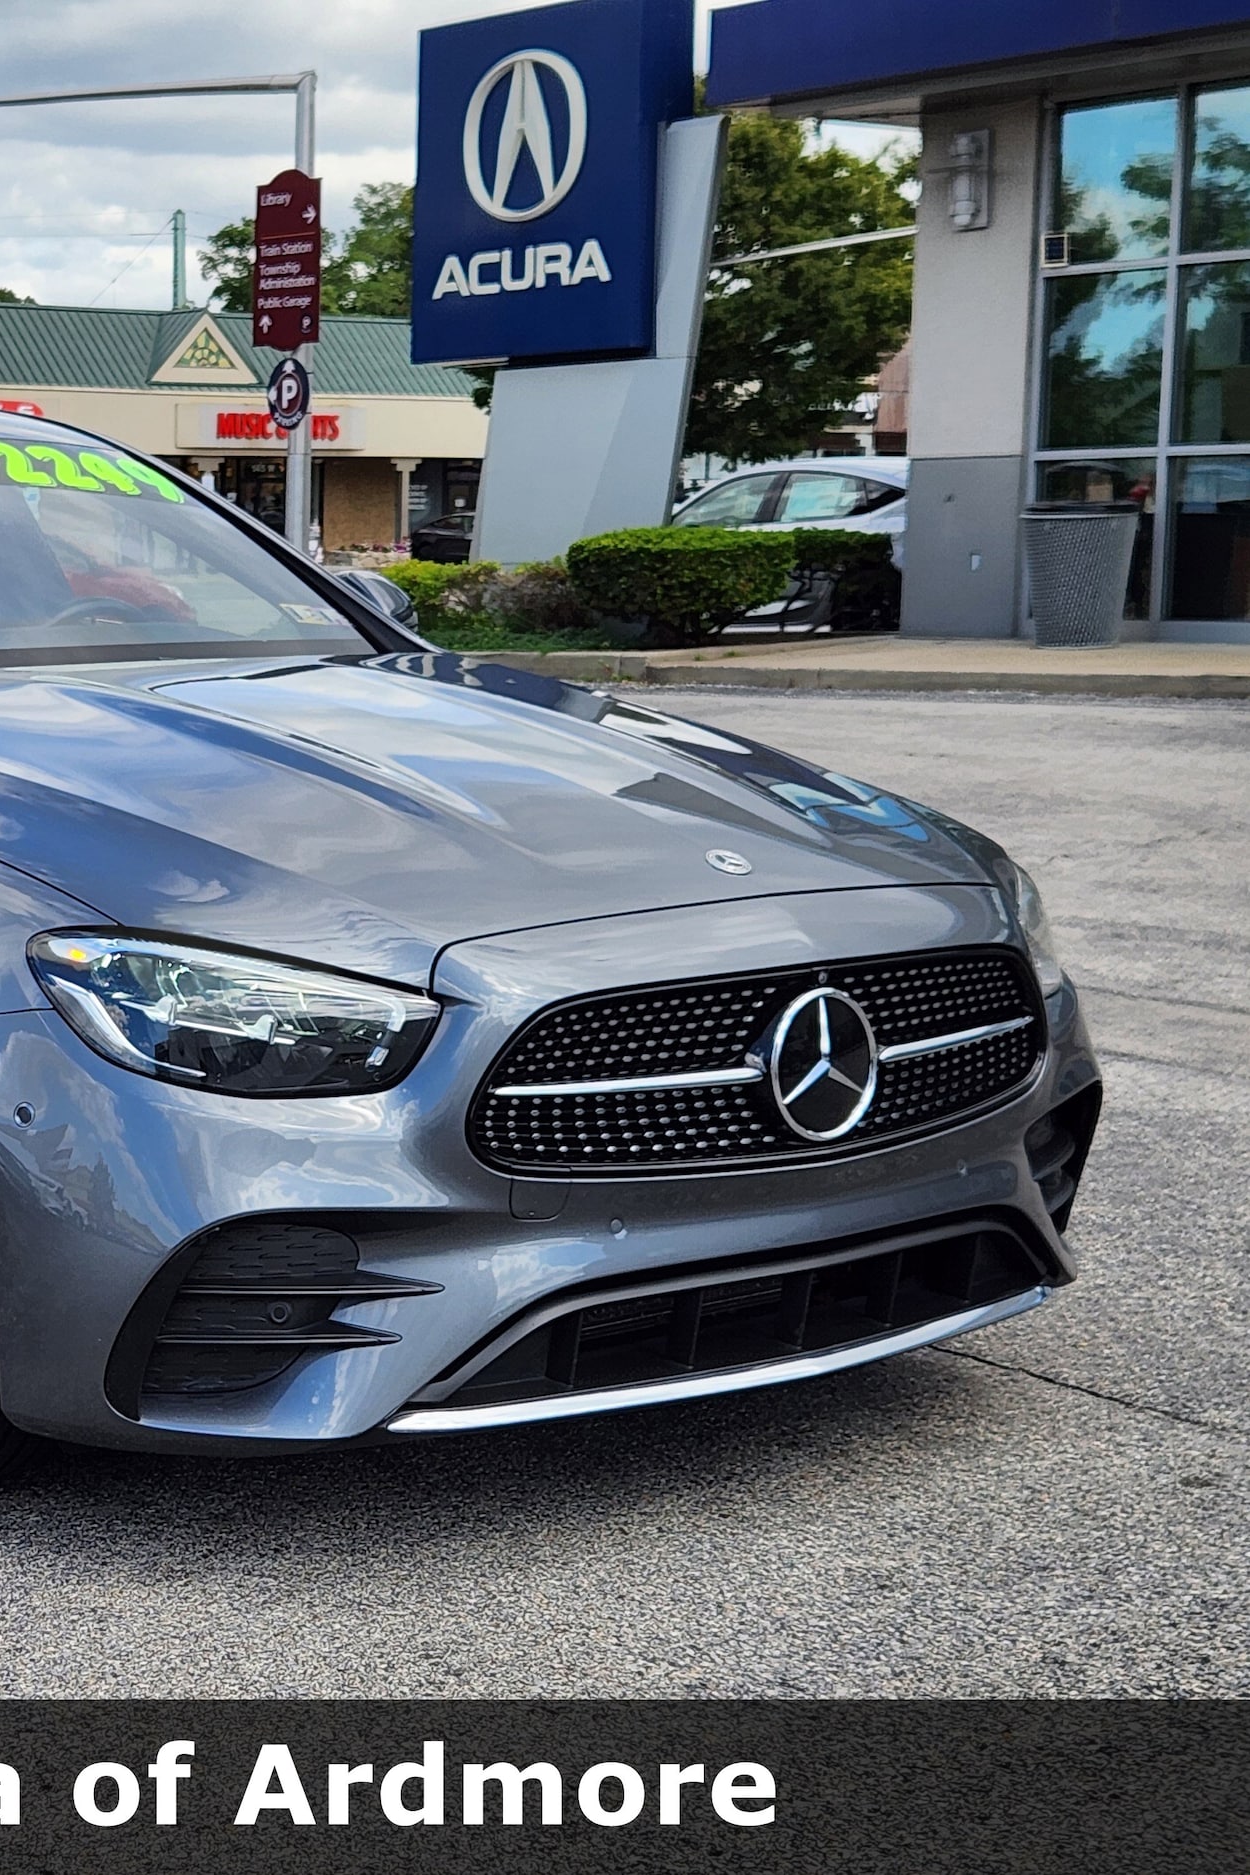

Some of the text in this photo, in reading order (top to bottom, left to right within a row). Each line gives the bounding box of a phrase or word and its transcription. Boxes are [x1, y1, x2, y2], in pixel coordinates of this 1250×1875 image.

[261, 192, 293, 207] Library
[259, 242, 313, 257] Train Station
[259, 261, 301, 276] Township
[432, 239, 612, 300] ACURA
[259, 276, 316, 290] Administration
[257, 296, 312, 309] Public Garage
[282, 379, 298, 409] P
[216, 413, 273, 439] MUSIC
